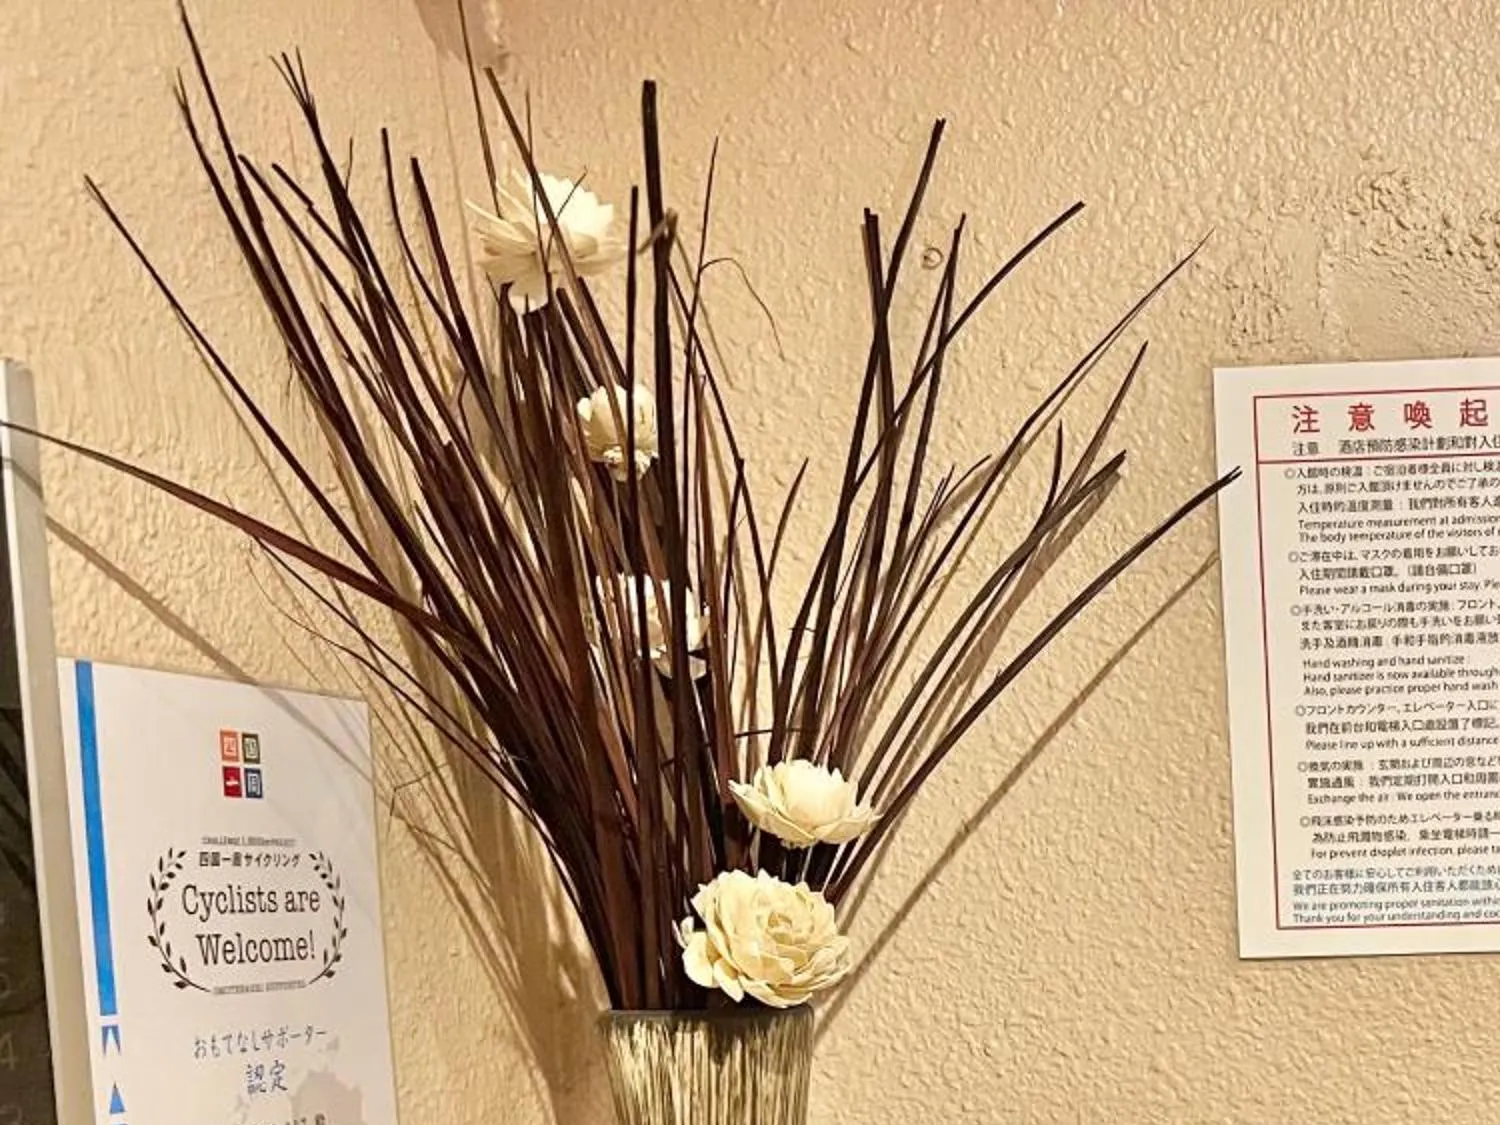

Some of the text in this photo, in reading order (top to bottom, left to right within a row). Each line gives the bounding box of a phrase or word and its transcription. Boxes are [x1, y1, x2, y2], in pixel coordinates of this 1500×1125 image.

[181, 884, 321, 922] Cyclists are
[196, 930, 317, 966] Welcome!
[245, 1060, 288, 1095] 認定
